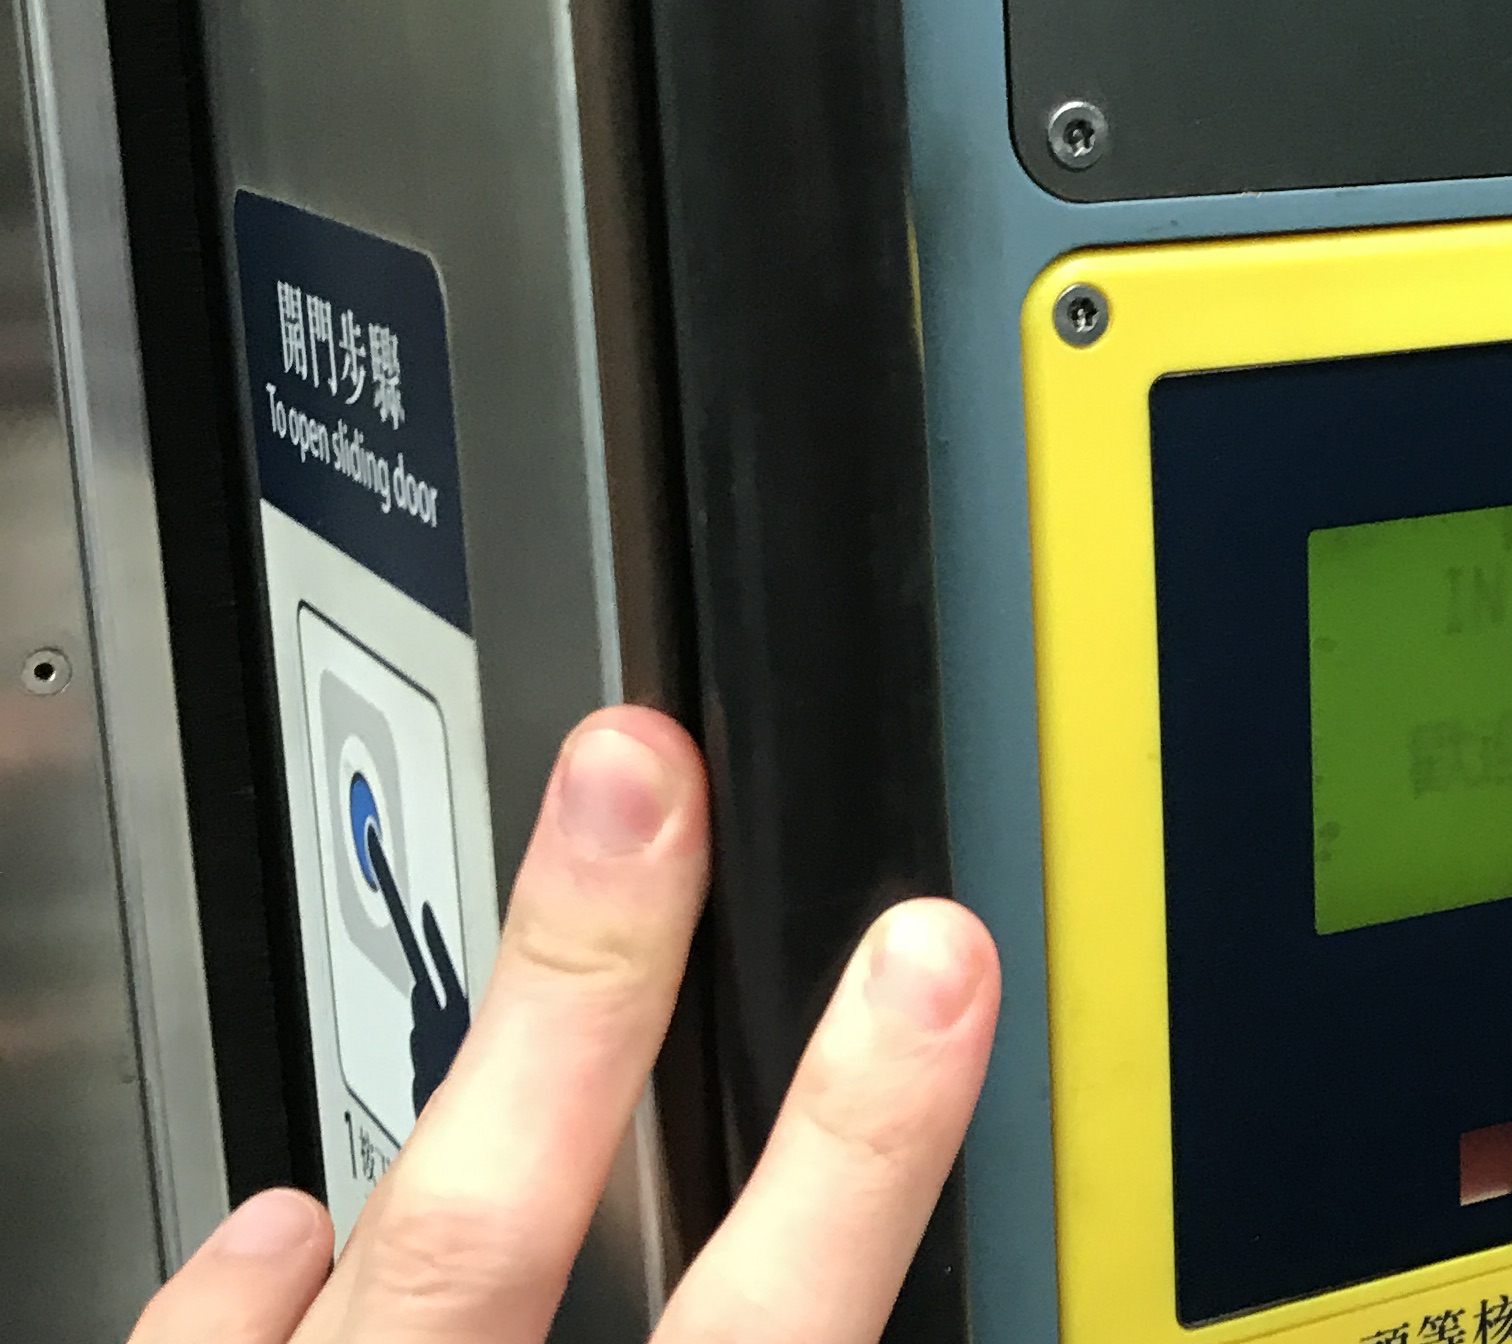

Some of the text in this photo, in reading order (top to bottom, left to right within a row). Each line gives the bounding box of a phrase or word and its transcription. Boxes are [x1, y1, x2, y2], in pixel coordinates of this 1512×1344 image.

[277, 280, 406, 431] 開門步驟
[265, 382, 438, 528] To open sliding door
[1445, 563, 1508, 636] IN
[344, 1110, 358, 1180] 1
